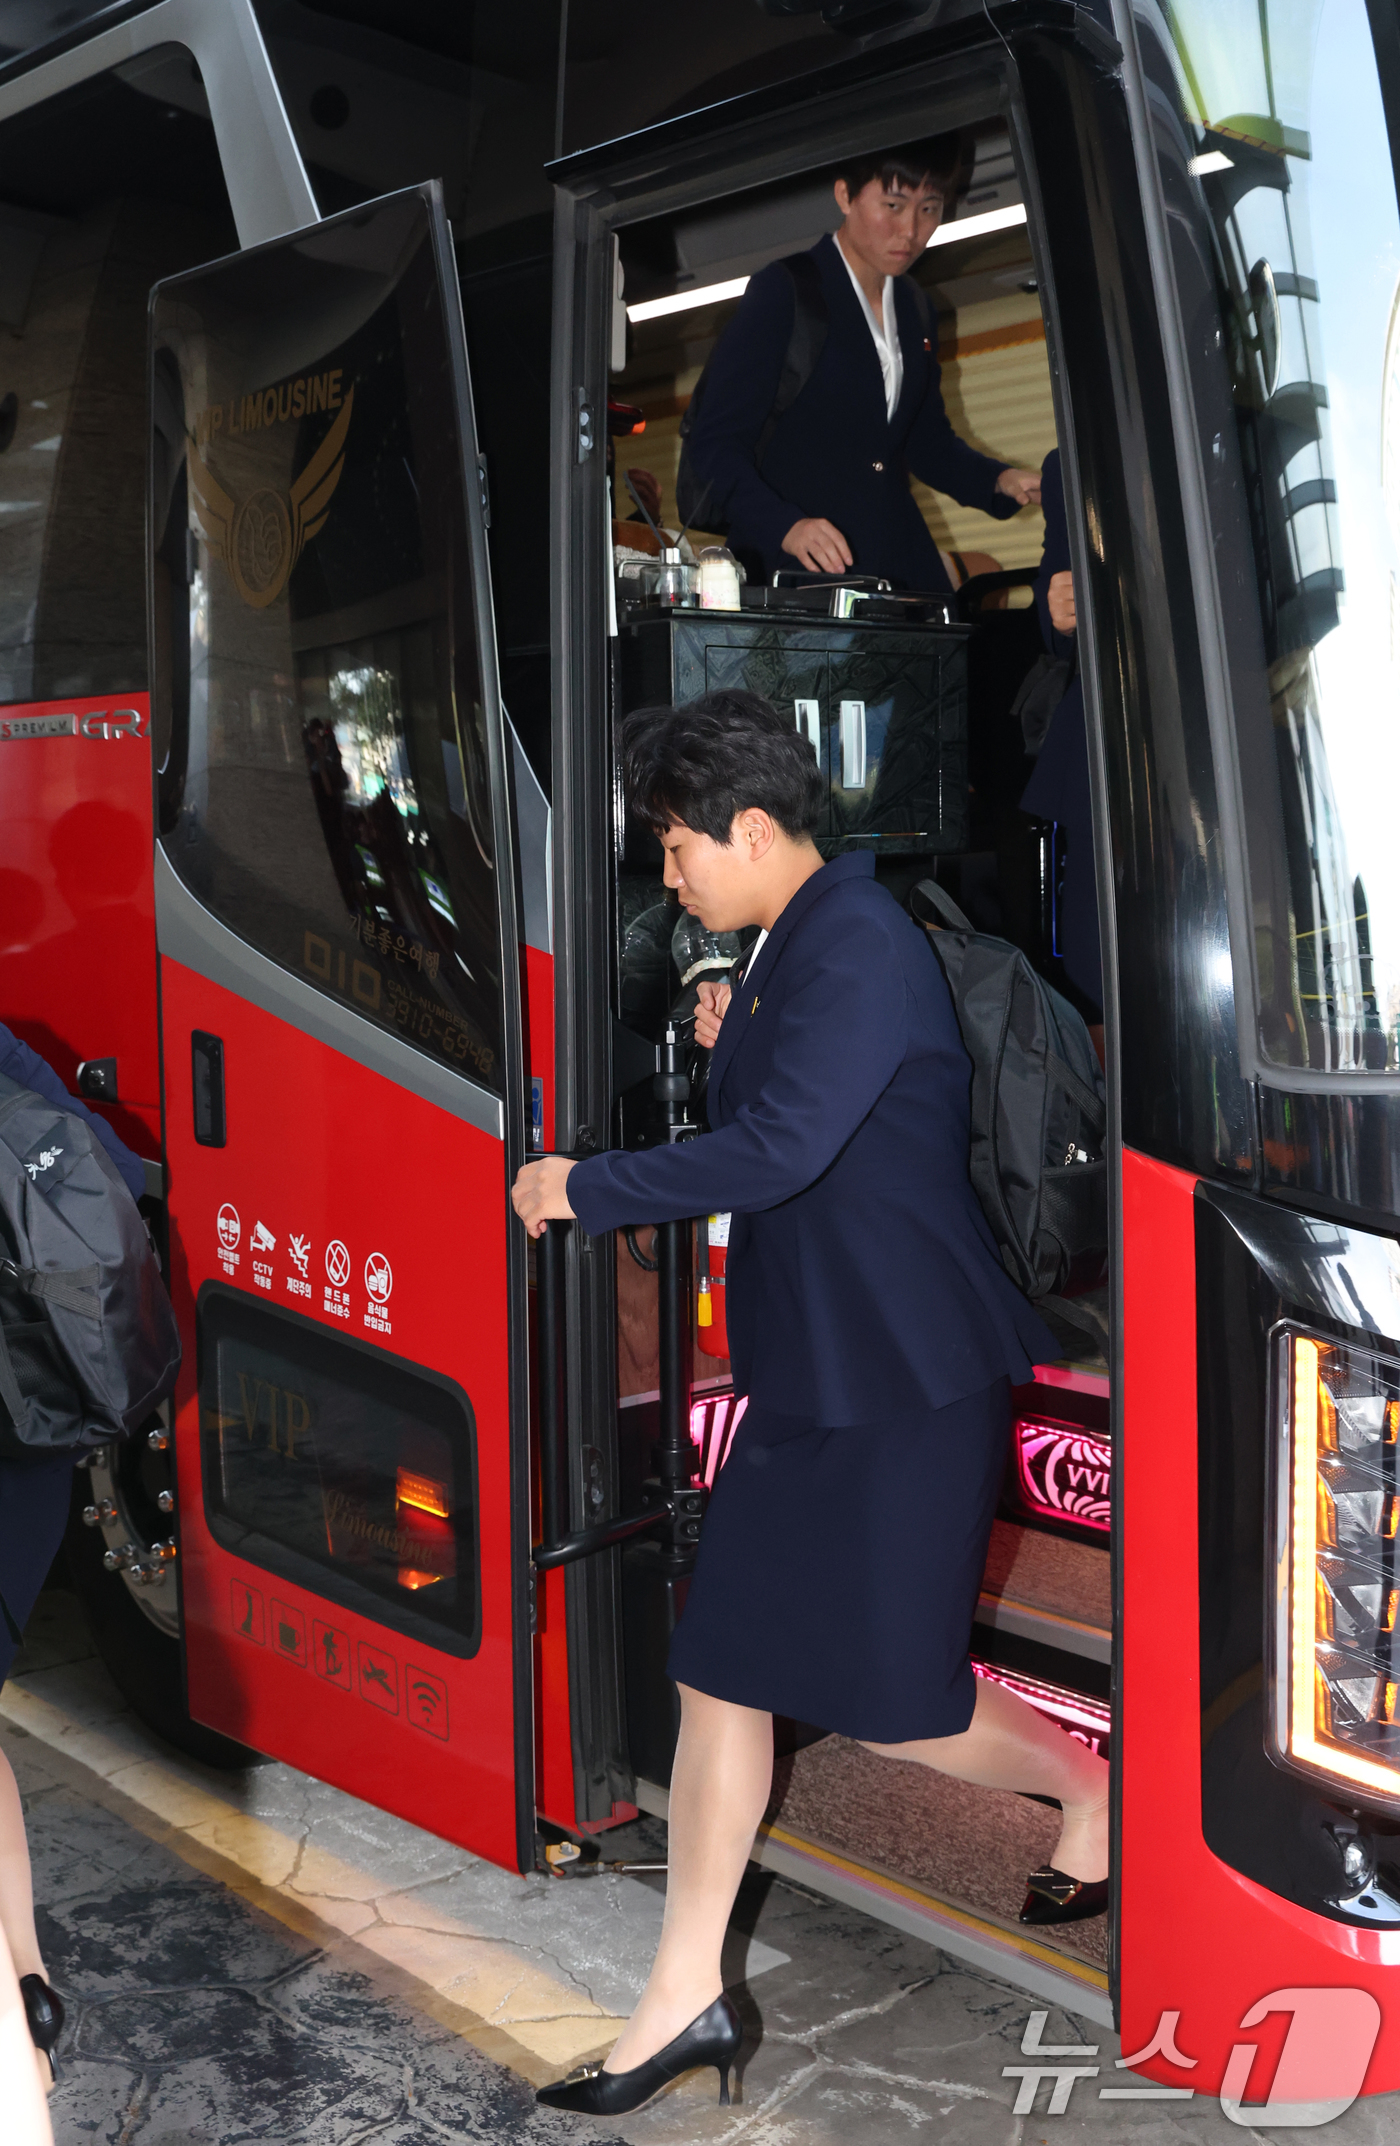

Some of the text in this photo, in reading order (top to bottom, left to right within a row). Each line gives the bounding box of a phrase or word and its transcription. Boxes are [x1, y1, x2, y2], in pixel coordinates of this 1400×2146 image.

[228, 368, 343, 435] LIMOUSINE
[80, 709, 151, 740] GR
[252, 1260, 273, 1276] CCTV
[286, 1276, 312, 1299] 계단주의
[323, 1299, 350, 1319] 매너준수
[367, 1301, 388, 1320] 음식물
[363, 1314, 392, 1335] 반입금지
[236, 1371, 311, 1461] VIP
